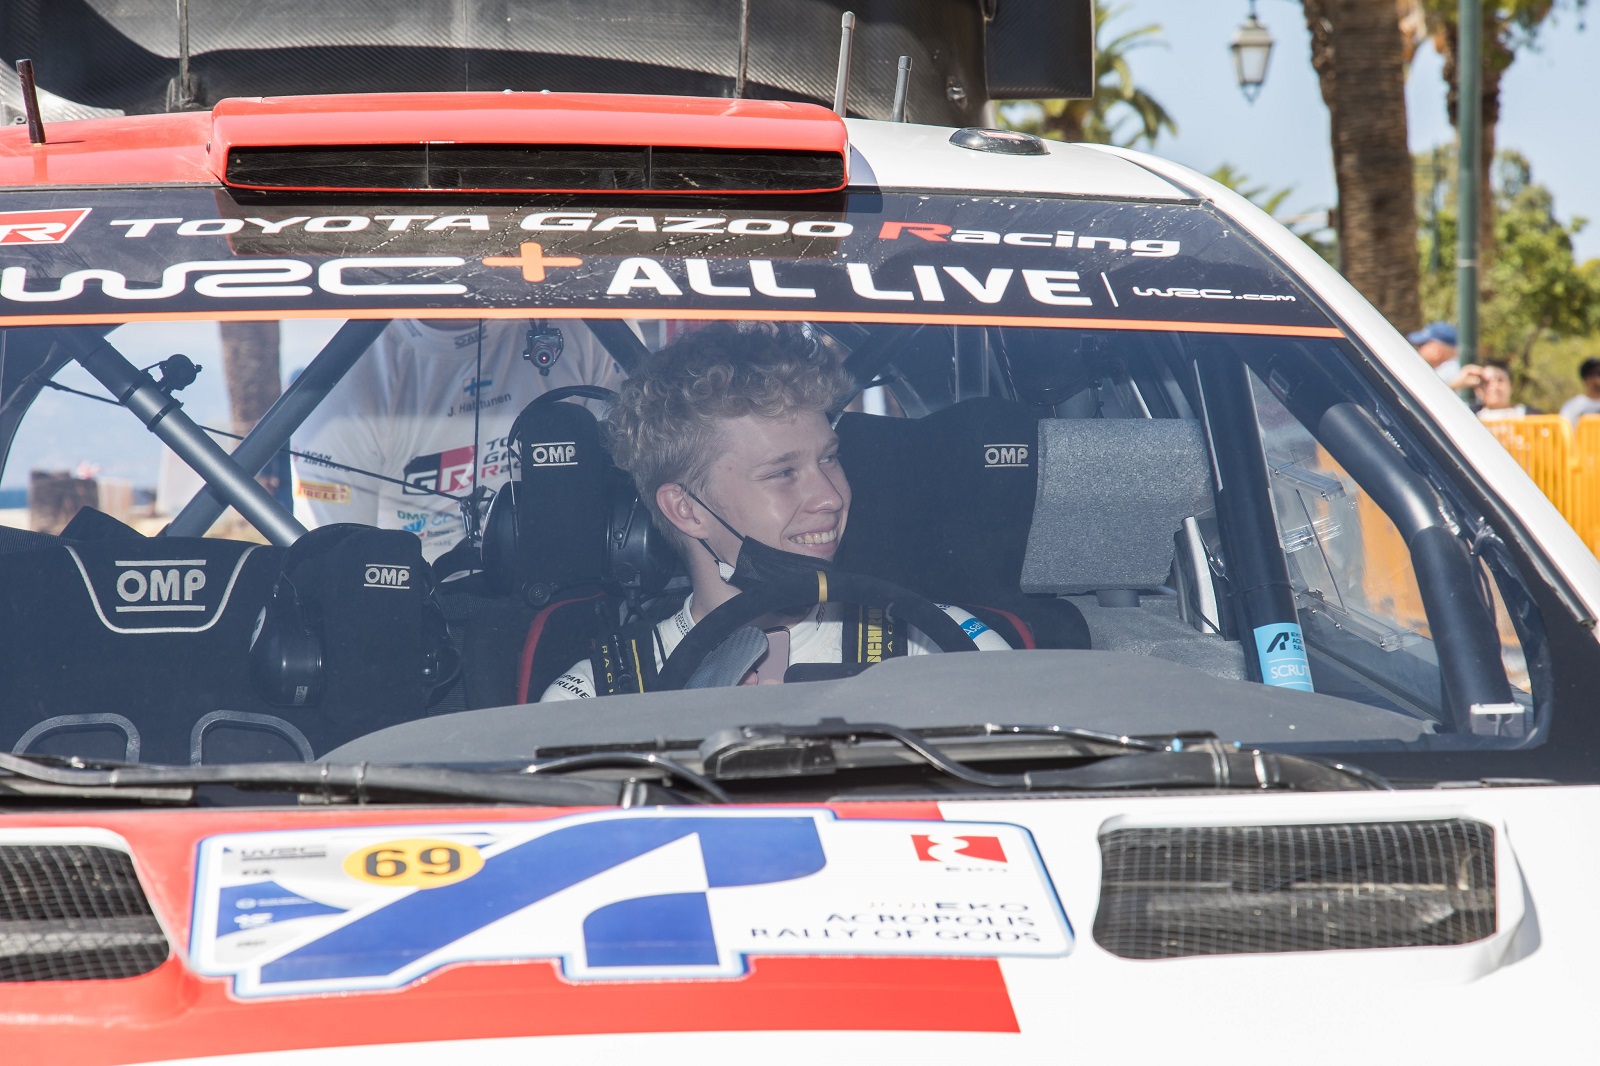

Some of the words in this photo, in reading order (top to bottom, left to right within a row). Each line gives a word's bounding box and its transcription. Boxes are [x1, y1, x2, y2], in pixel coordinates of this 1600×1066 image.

[110, 213, 490, 238] TOYOTA
[520, 211, 854, 238] GAZOO
[878, 221, 1181, 258] Racing
[605, 257, 817, 298] ALL
[846, 262, 1092, 307] LIVE
[532, 445, 576, 463] OMP
[984, 447, 1029, 465] OMP
[365, 567, 410, 585] OMP
[116, 569, 206, 602] OMP
[366, 847, 461, 877] 69
[827, 914, 1036, 926] ACROPOLIS
[751, 928, 858, 939] RALLY
[874, 929, 922, 940] OF
[935, 930, 1041, 942] GODS
